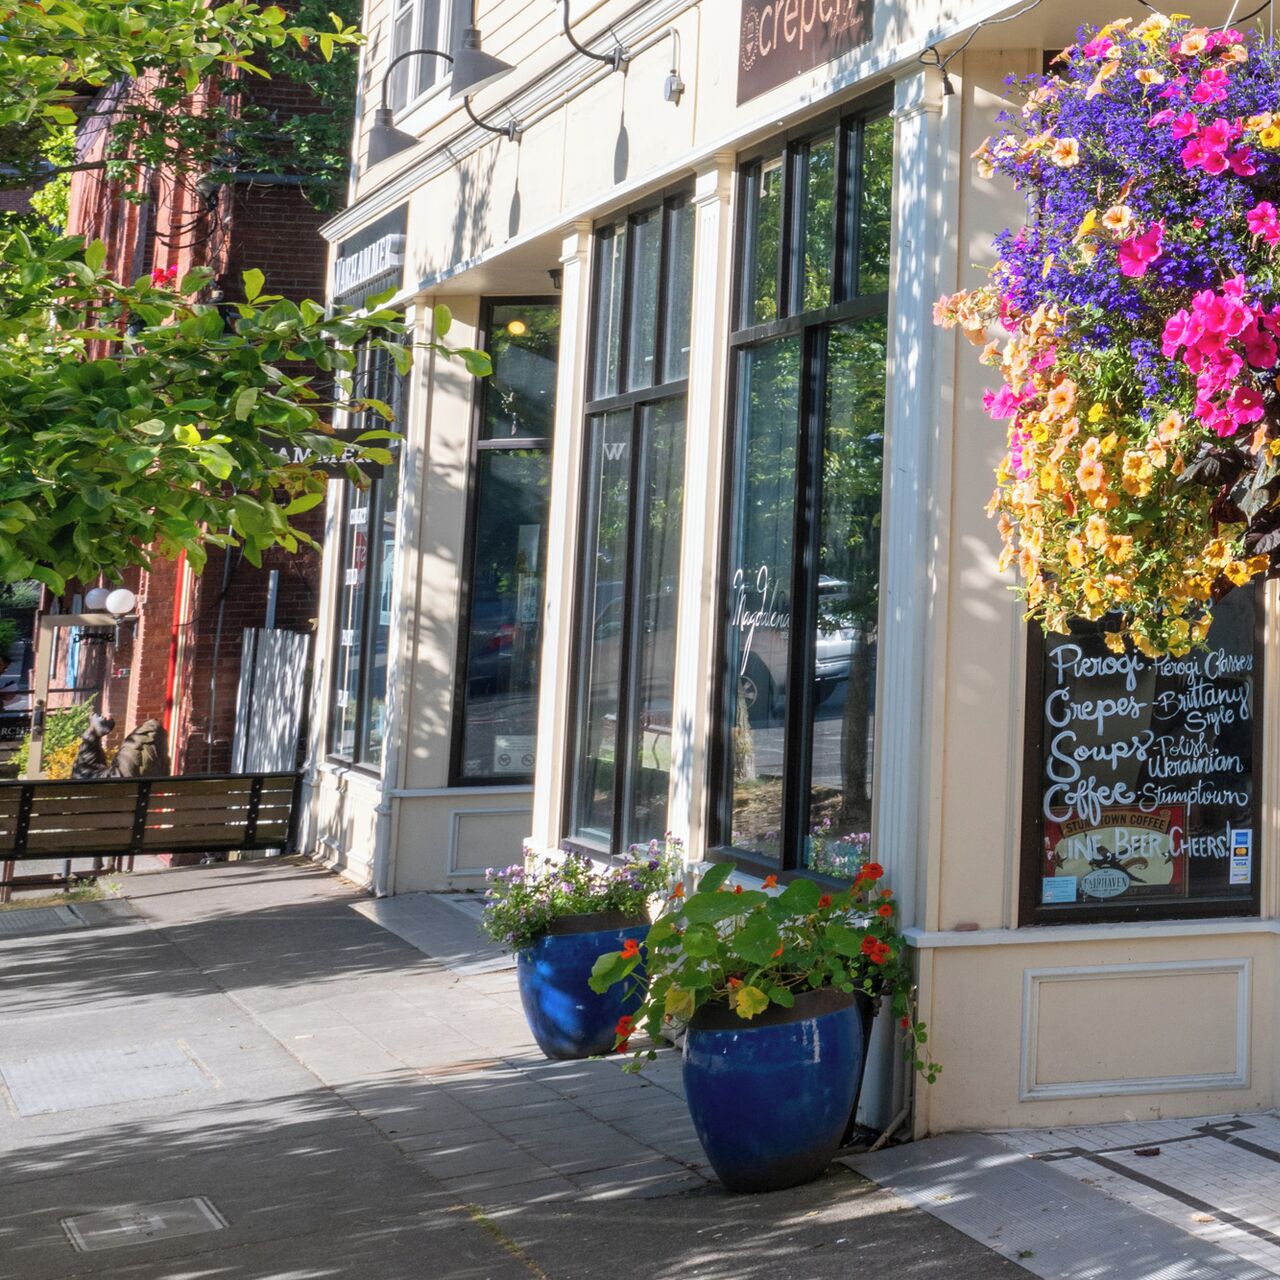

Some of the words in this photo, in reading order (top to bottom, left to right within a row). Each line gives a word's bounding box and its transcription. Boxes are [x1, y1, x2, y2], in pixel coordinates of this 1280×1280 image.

[1045, 686, 1144, 736] Crepes
[1184, 706, 1235, 736] Style
[1046, 730, 1155, 783] Soups
[1148, 753, 1244, 778] Ukrainian
[1043, 775, 1137, 826] Coffee
[1132, 814, 1165, 830] COFFEE
